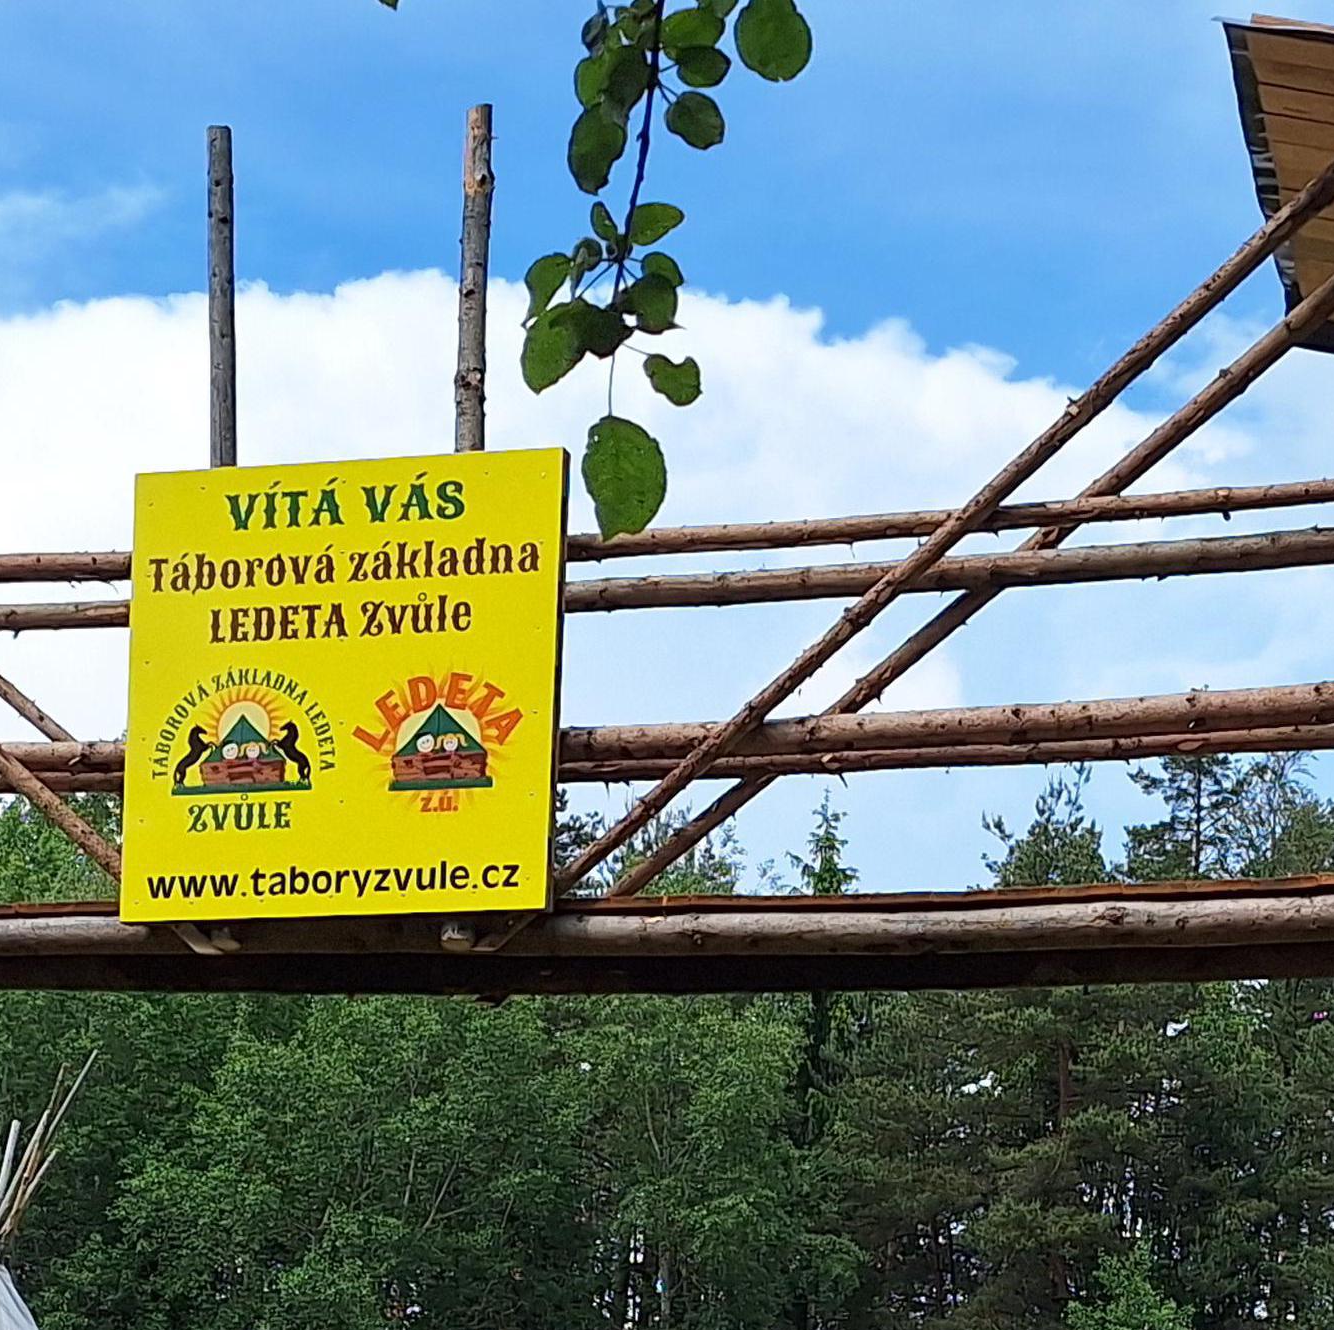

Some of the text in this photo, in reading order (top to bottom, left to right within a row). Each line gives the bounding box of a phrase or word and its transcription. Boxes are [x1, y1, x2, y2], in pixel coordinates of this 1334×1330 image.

[226, 472, 465, 531] VÍTÁ VÁS
[148, 537, 540, 595] Táborová základna
[208, 592, 472, 644] LEDETA Zvůle
[149, 665, 336, 780] TÁBOROVÁ ZÁKLADNA LEDETA
[352, 672, 524, 752] LEDETA
[187, 793, 292, 833] ZVŮLE
[147, 861, 520, 899] www.taboryzvule.cz
